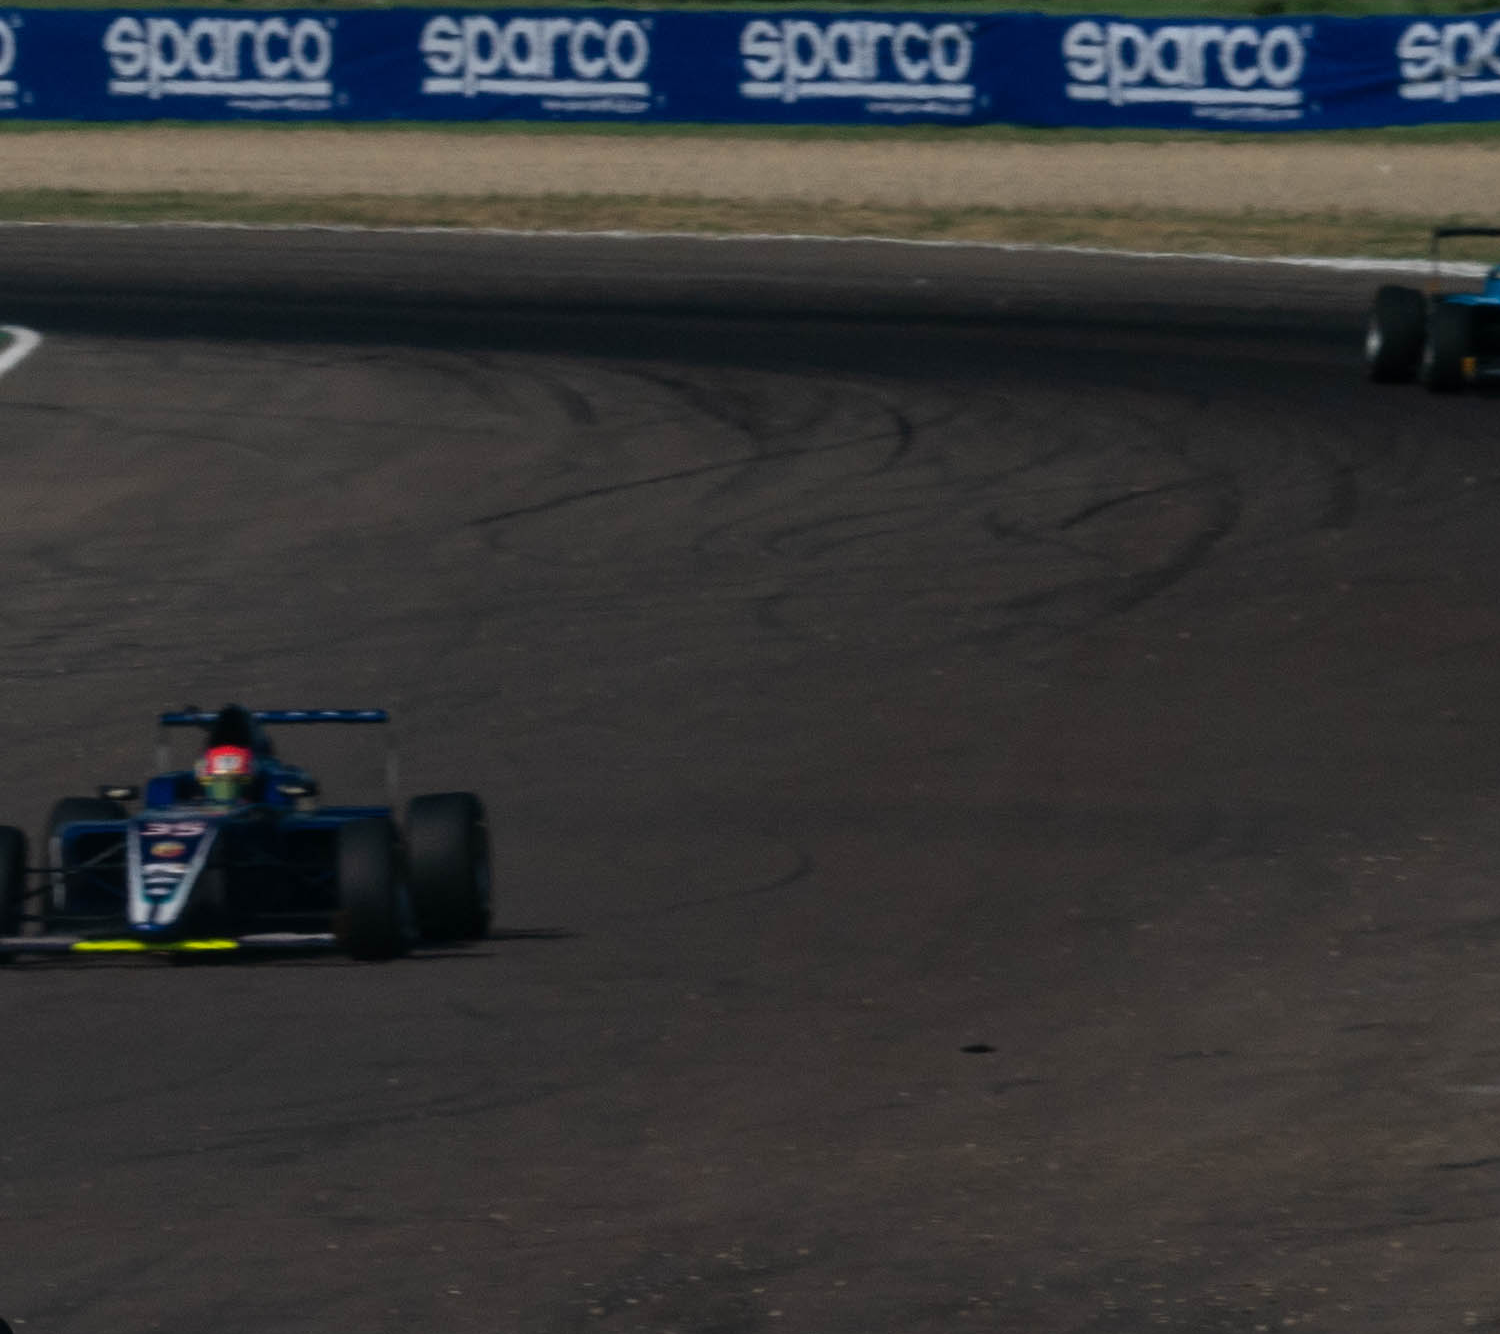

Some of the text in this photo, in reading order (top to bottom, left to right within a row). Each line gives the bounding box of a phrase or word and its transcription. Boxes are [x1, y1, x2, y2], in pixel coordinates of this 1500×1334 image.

[103, 16, 333, 99] sparco
[419, 15, 650, 98] sparco
[739, 19, 973, 102] sparco
[1062, 20, 1303, 106] sparco
